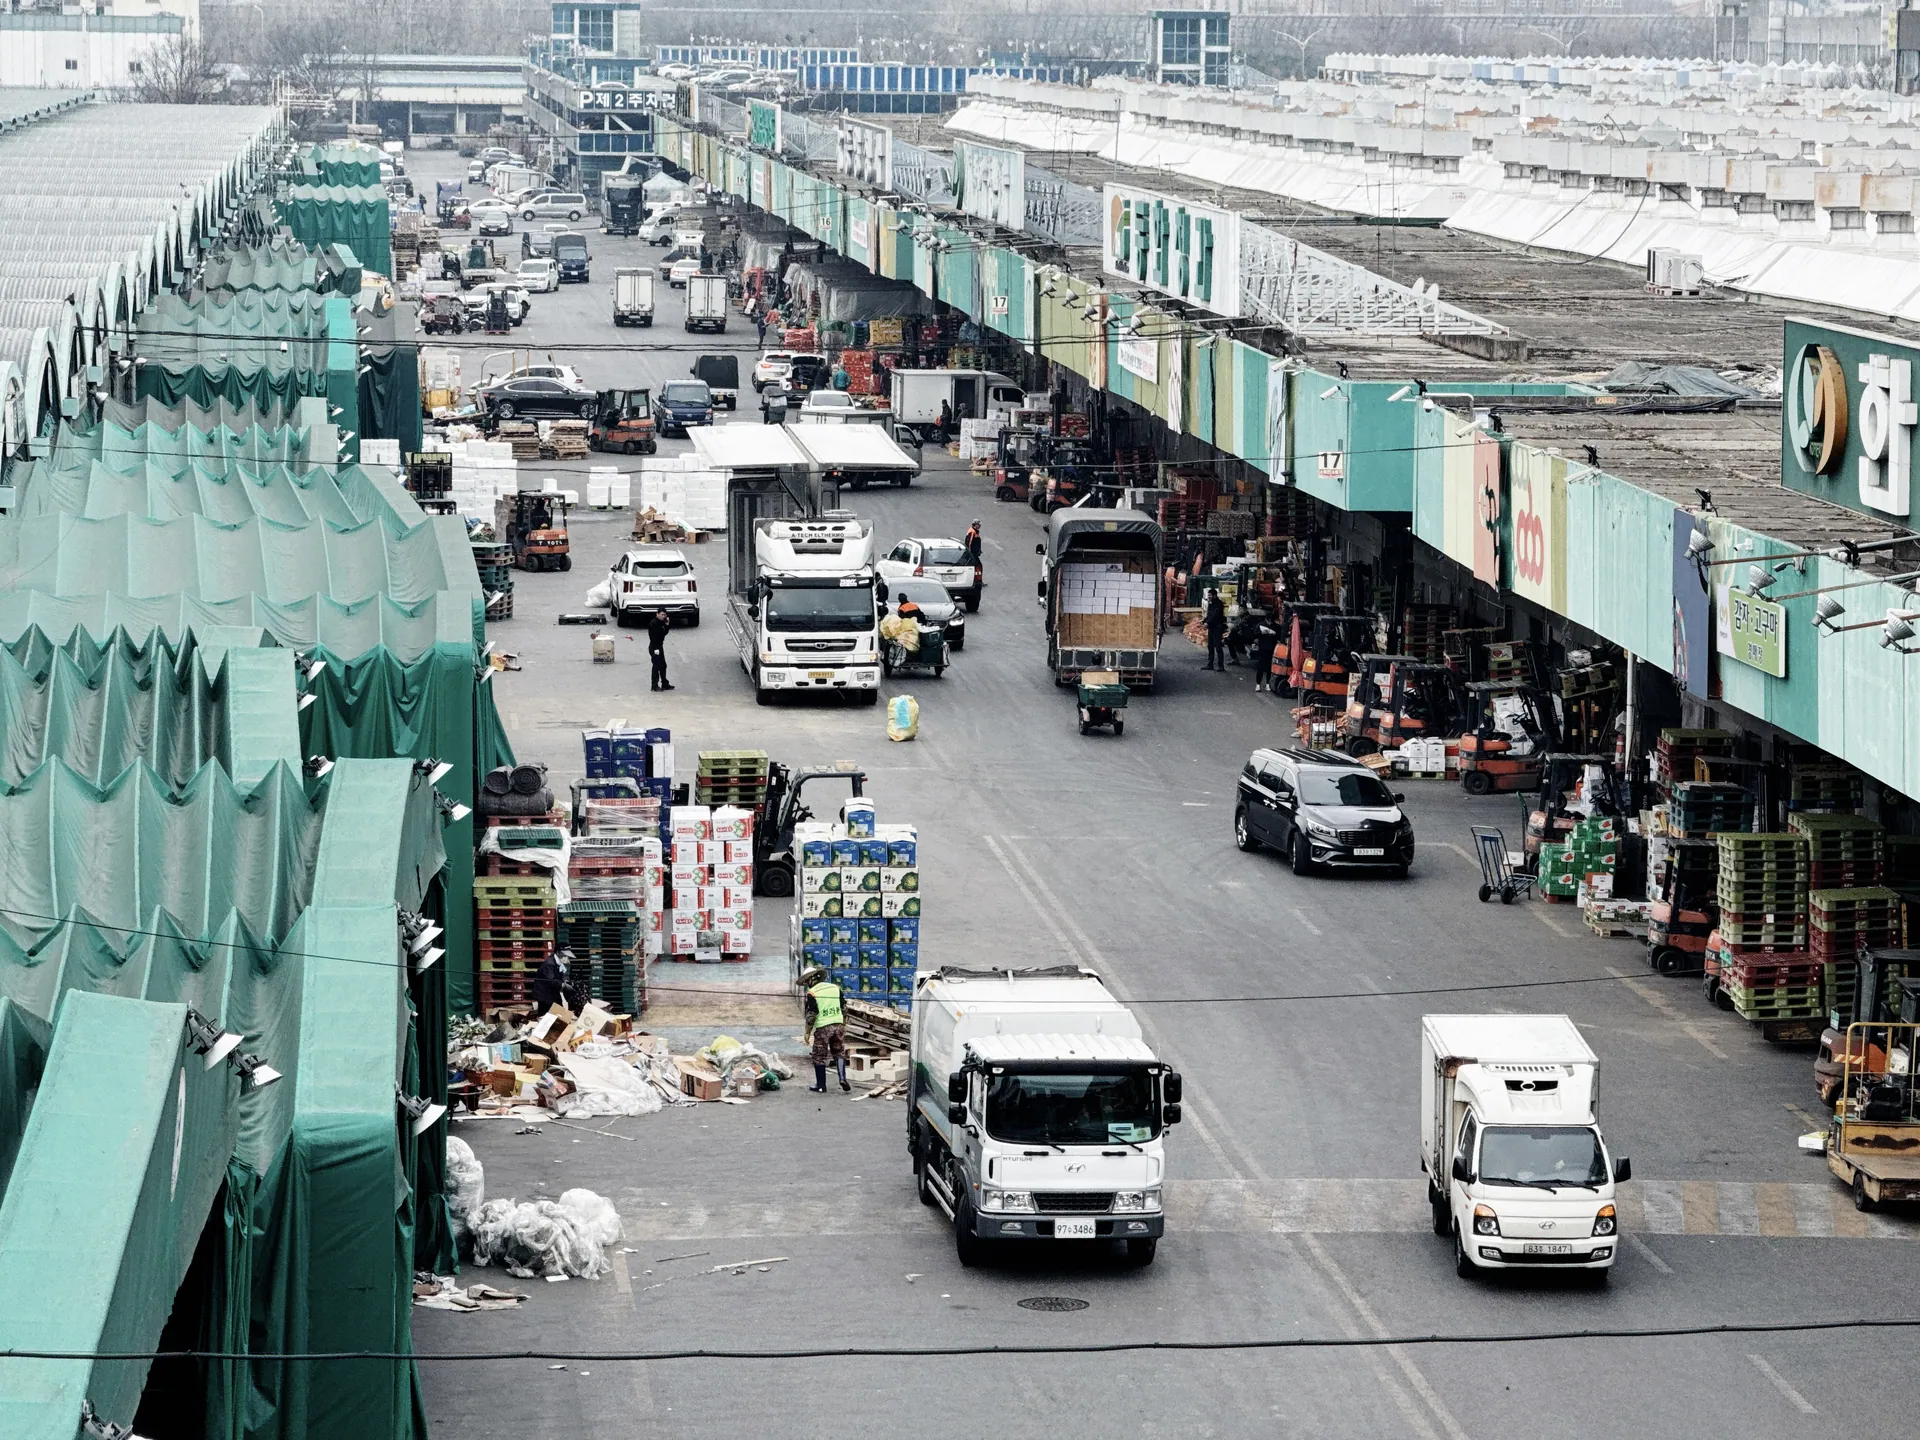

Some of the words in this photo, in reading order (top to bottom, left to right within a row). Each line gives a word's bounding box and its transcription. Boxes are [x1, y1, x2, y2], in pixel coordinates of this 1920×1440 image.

[821, 217, 831, 226] 16
[993, 296, 1007, 308] 17
[1320, 452, 1341, 469] 17
[1747, 642, 1763, 665] 경매장
[1547, 1245, 1568, 1253] 1847
